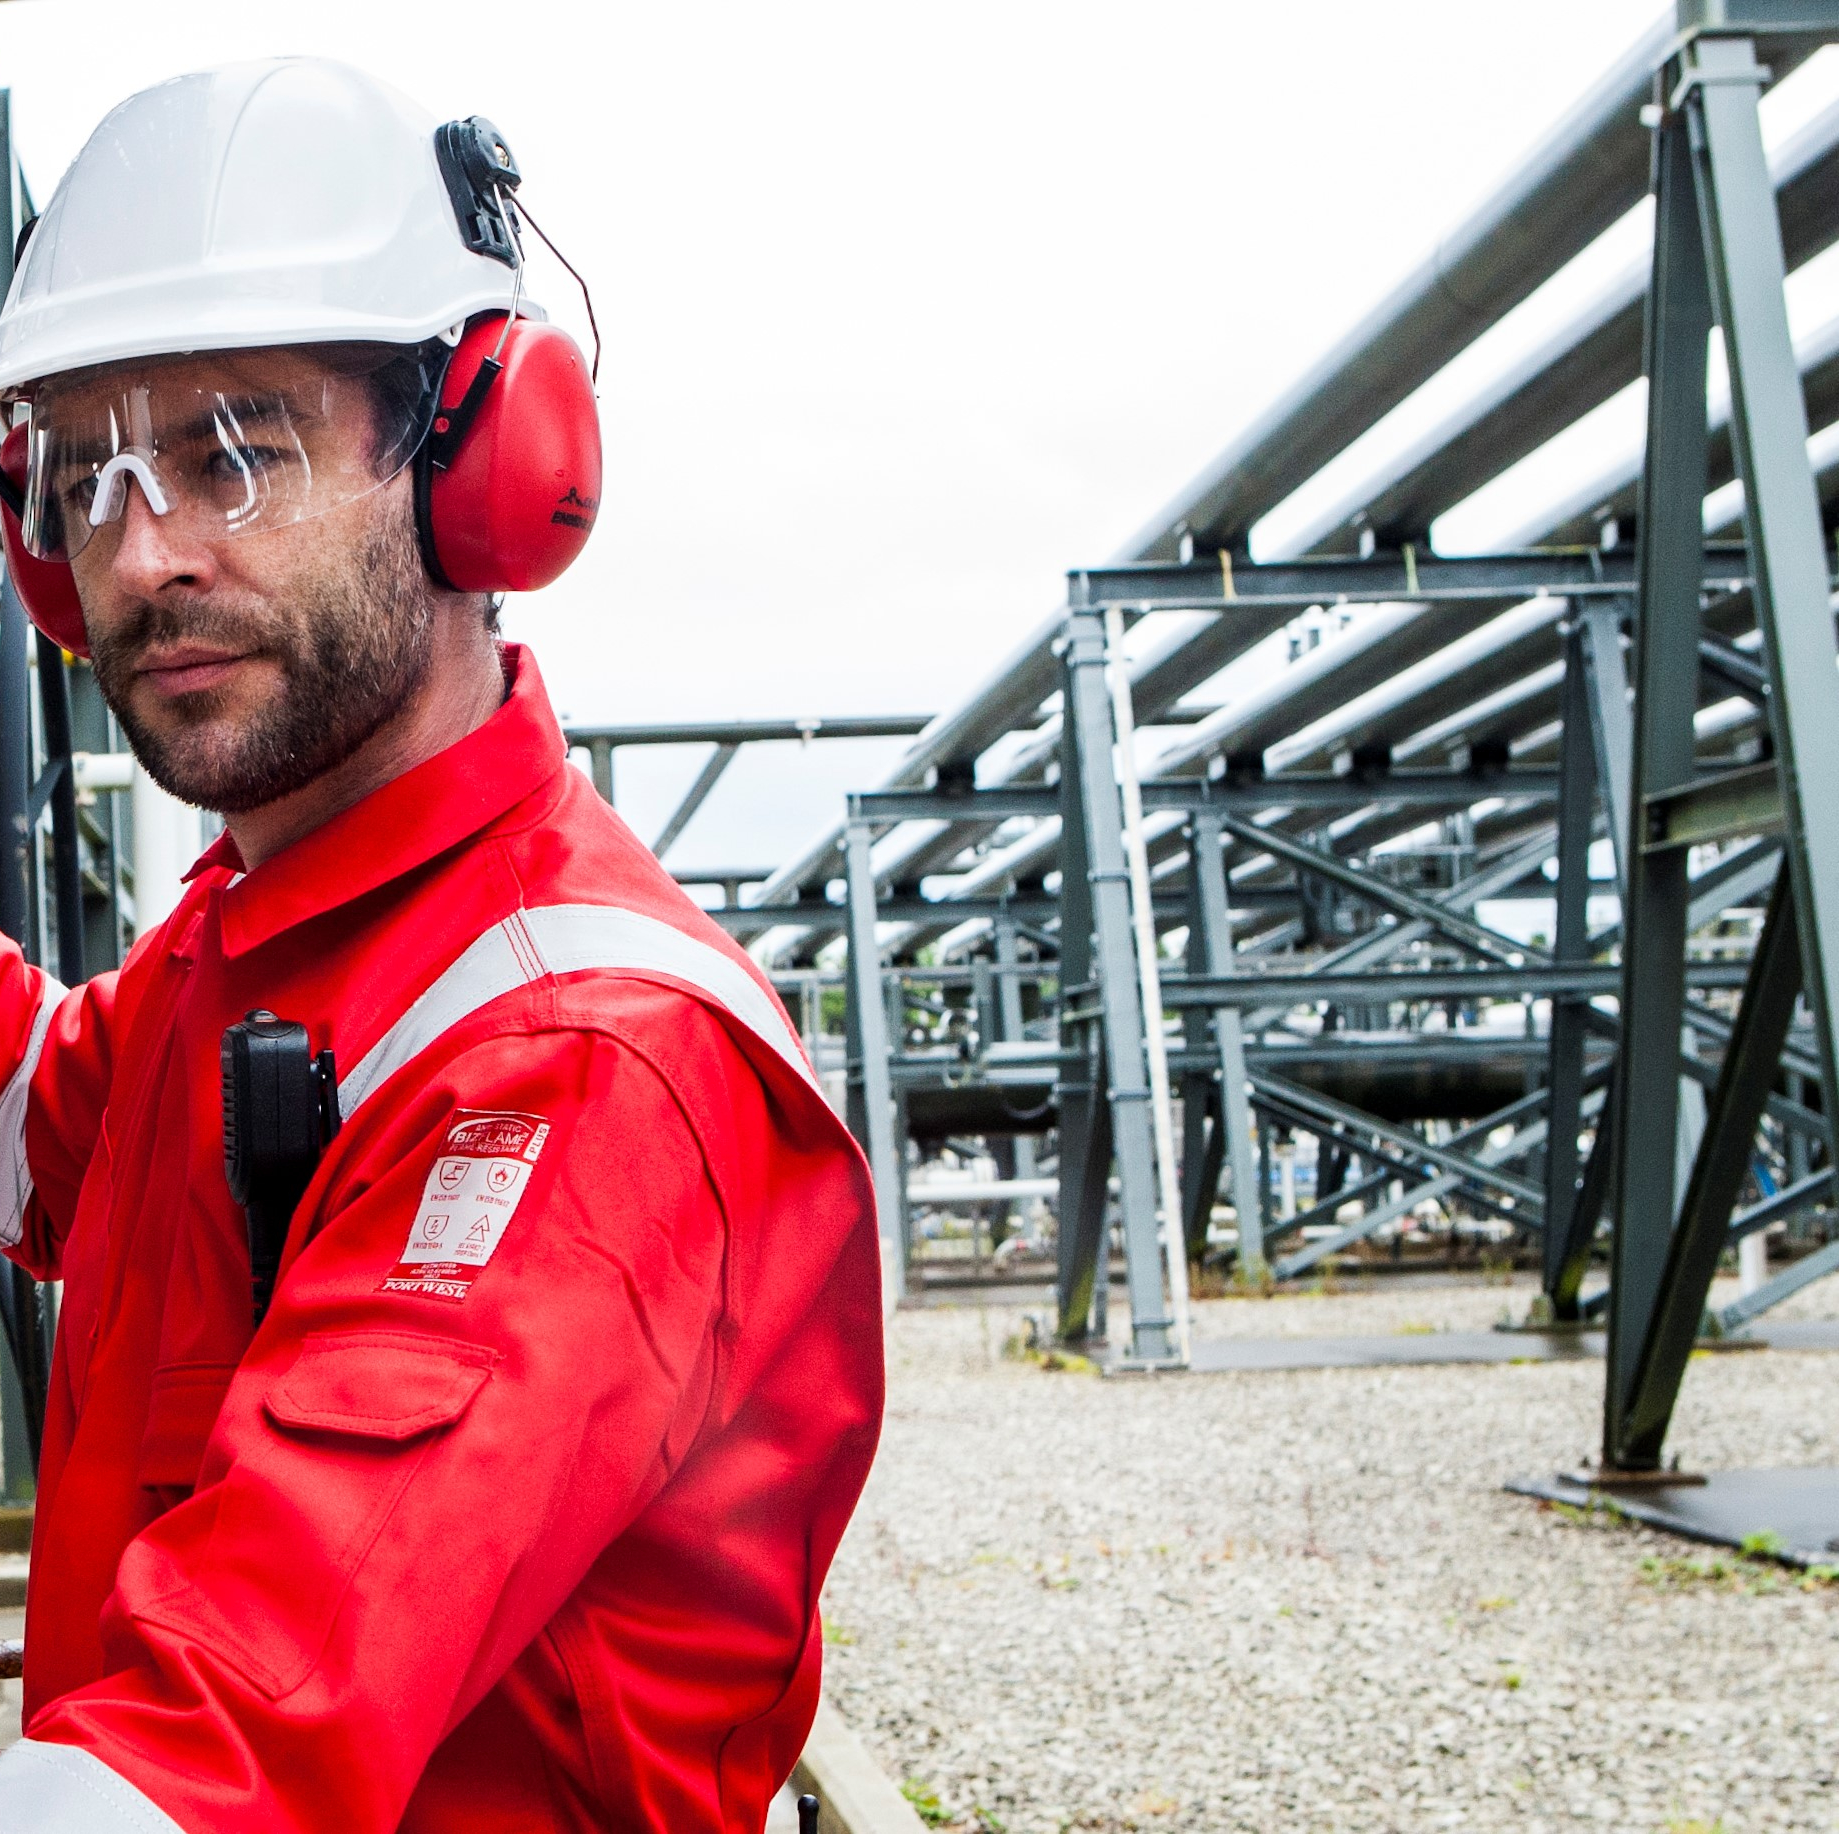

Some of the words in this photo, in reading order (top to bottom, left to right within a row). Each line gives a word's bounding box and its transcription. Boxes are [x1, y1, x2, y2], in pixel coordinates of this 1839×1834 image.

[454, 1131, 526, 1145] BIZLAME
[529, 1126, 547, 1154] PLUS
[382, 1281, 466, 1299] PORTWEST
